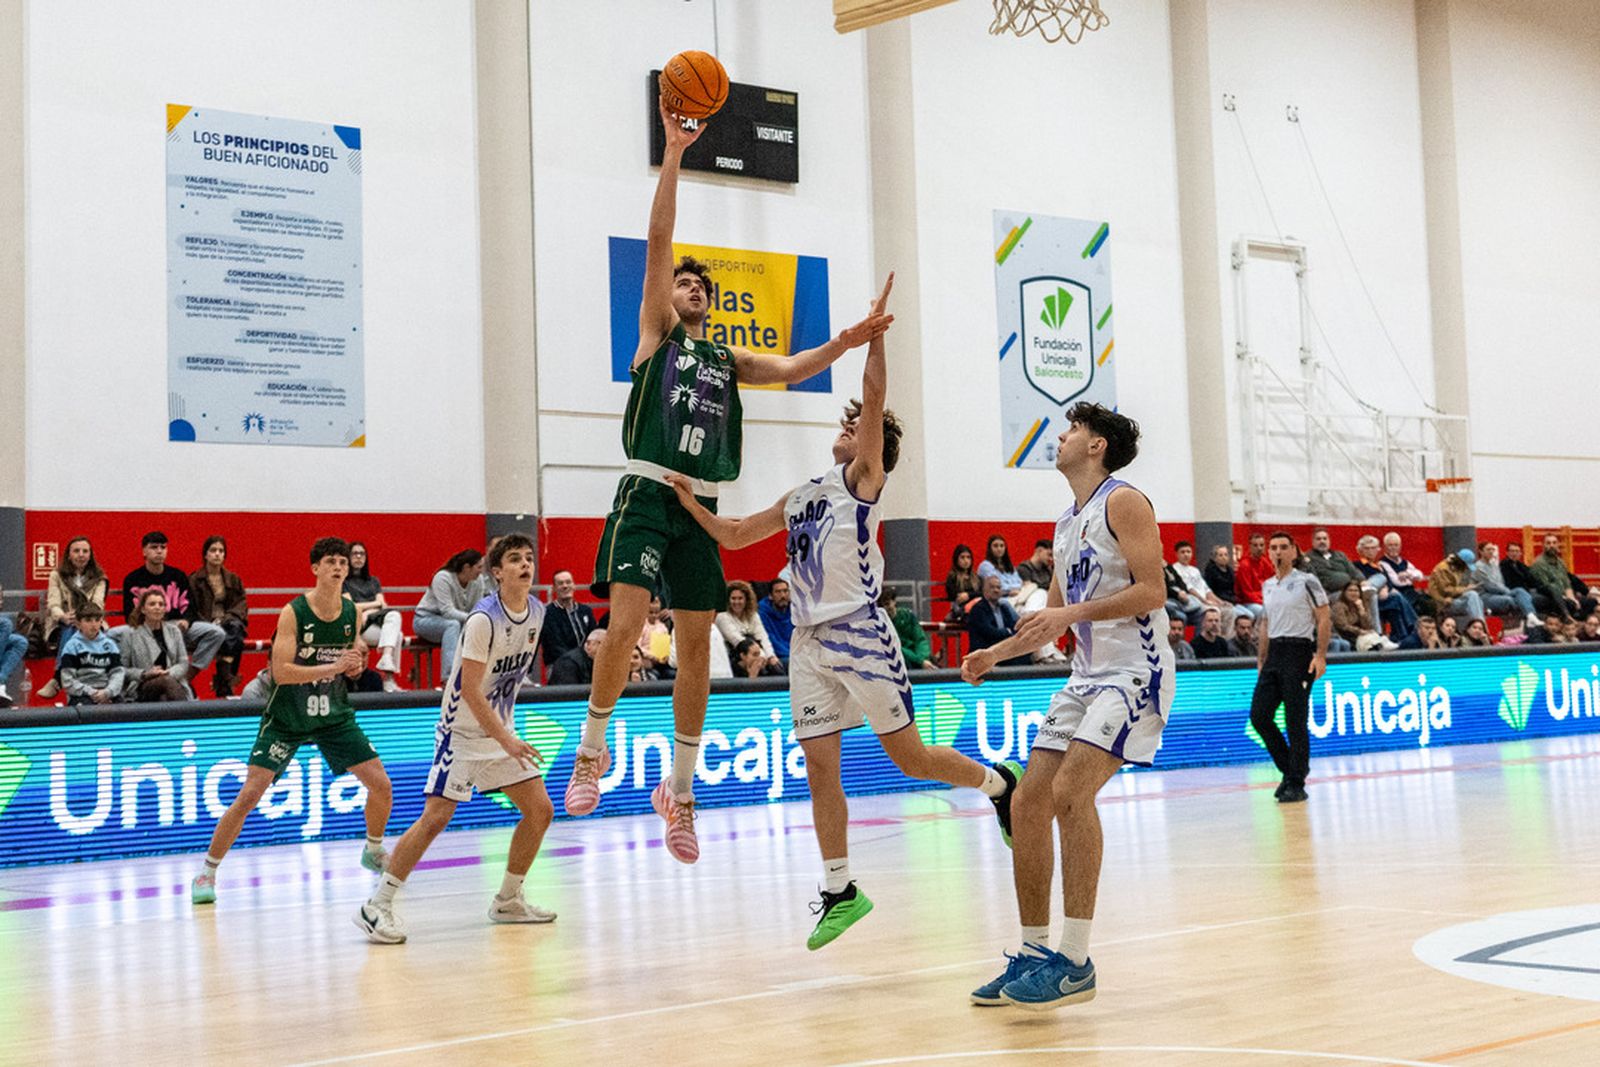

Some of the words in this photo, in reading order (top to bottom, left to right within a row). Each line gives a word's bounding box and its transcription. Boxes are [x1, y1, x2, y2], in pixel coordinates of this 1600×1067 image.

[193, 130, 221, 146] LOS
[223, 134, 310, 156] PRINCIPIOS
[312, 145, 339, 160] DEL
[756, 126, 794, 144] VISITANTE
[203, 148, 243, 164] BUEN
[245, 152, 330, 174] AFICIONADO
[713, 282, 755, 313] las
[701, 314, 779, 348] fante
[1034, 337, 1083, 352] Fundación
[1034, 366, 1084, 379] Baloncesto
[1042, 353, 1077, 369] Unicaja
[678, 424, 706, 456] 16
[306, 695, 330, 716] 99
[1545, 664, 1600, 720] Uni
[1307, 673, 1451, 746] Unicaja
[580, 707, 807, 798] Uncaja
[50, 739, 368, 837] Unicaja
